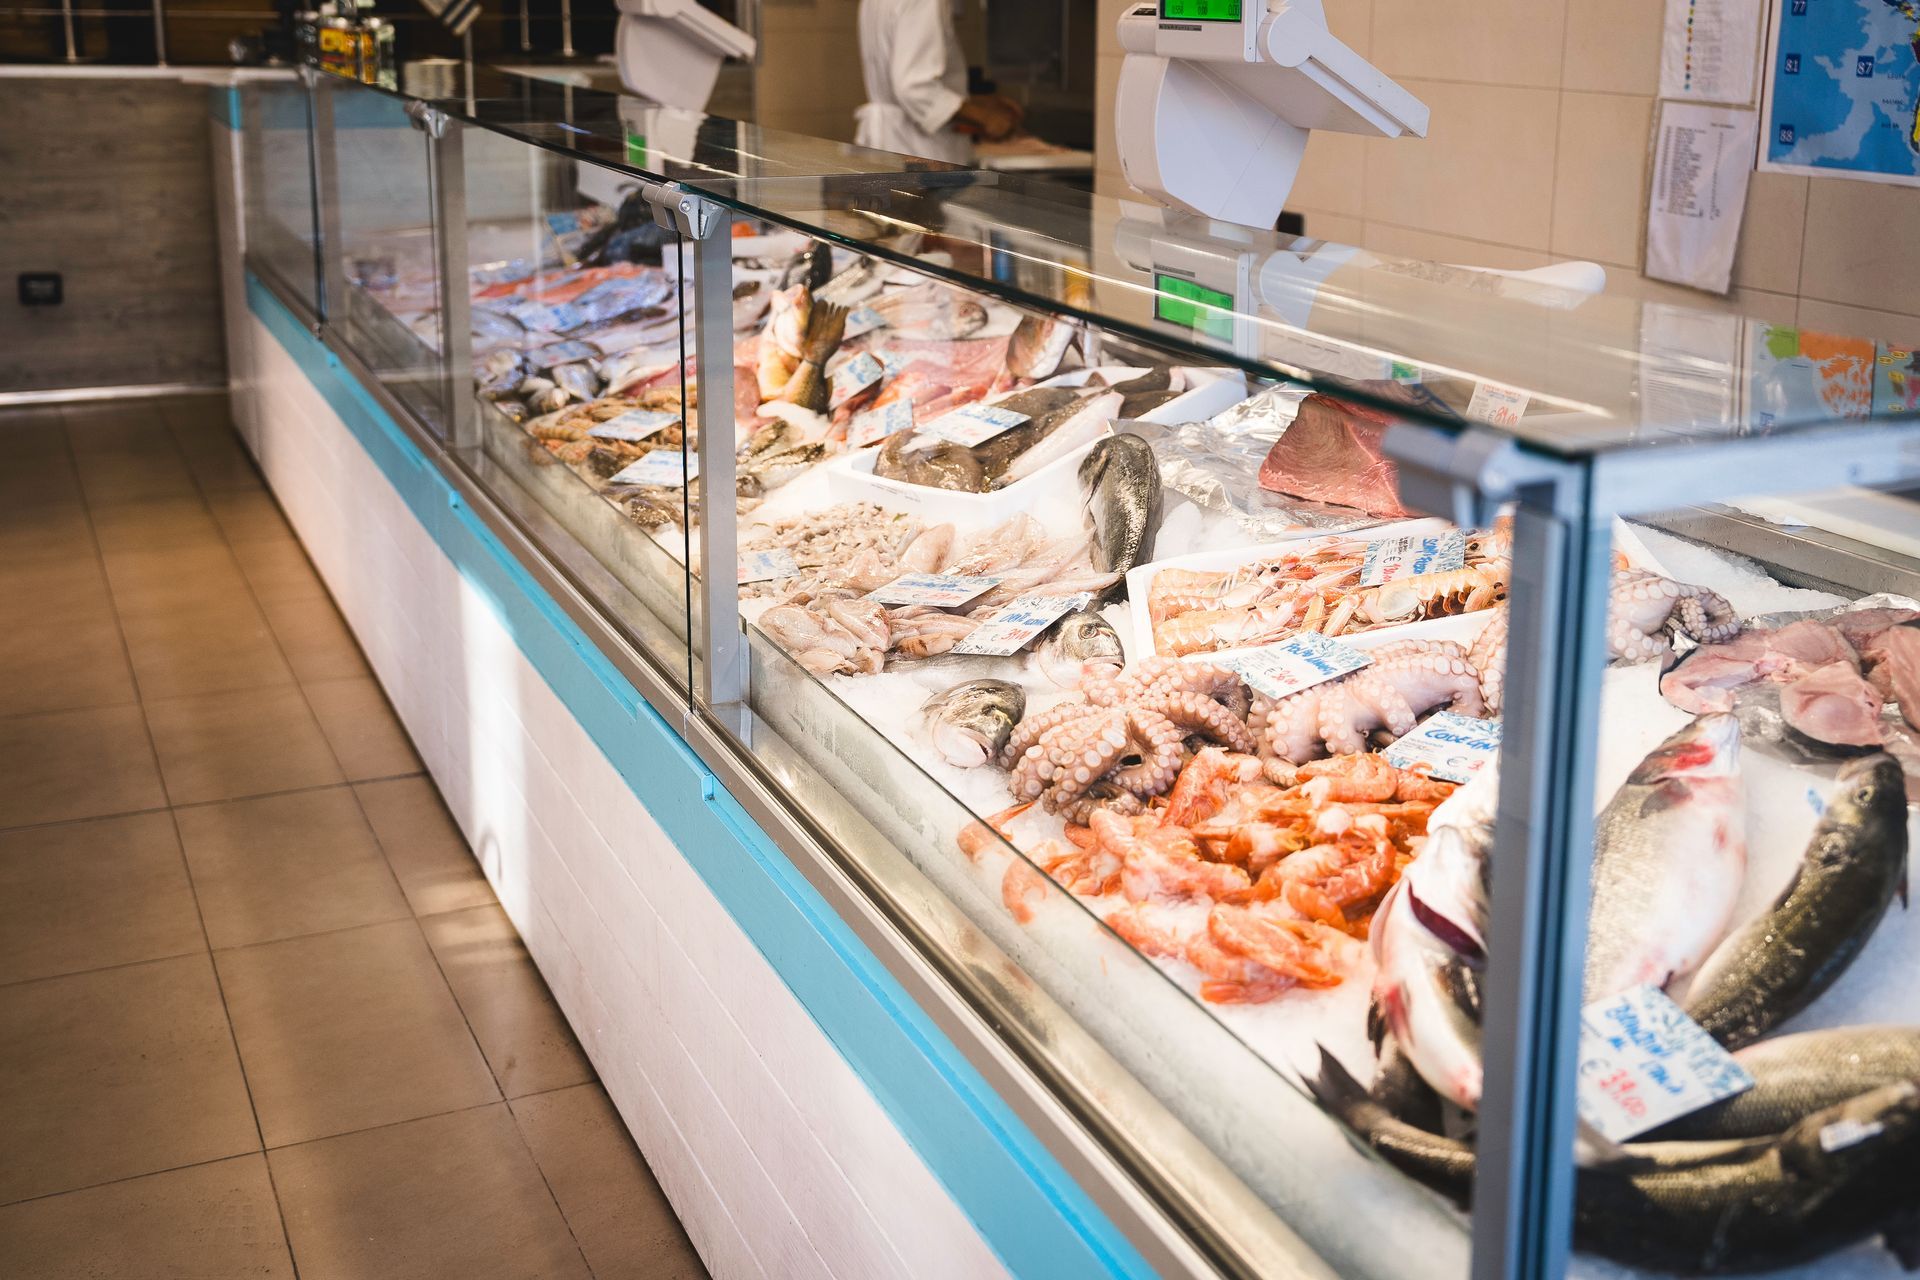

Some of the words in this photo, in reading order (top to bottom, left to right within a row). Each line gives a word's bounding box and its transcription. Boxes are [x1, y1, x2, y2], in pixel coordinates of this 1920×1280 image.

[1792, 0, 1806, 13] 77
[1785, 59, 1798, 72] 81
[1857, 61, 1873, 74] 87
[1780, 130, 1794, 142] 88
